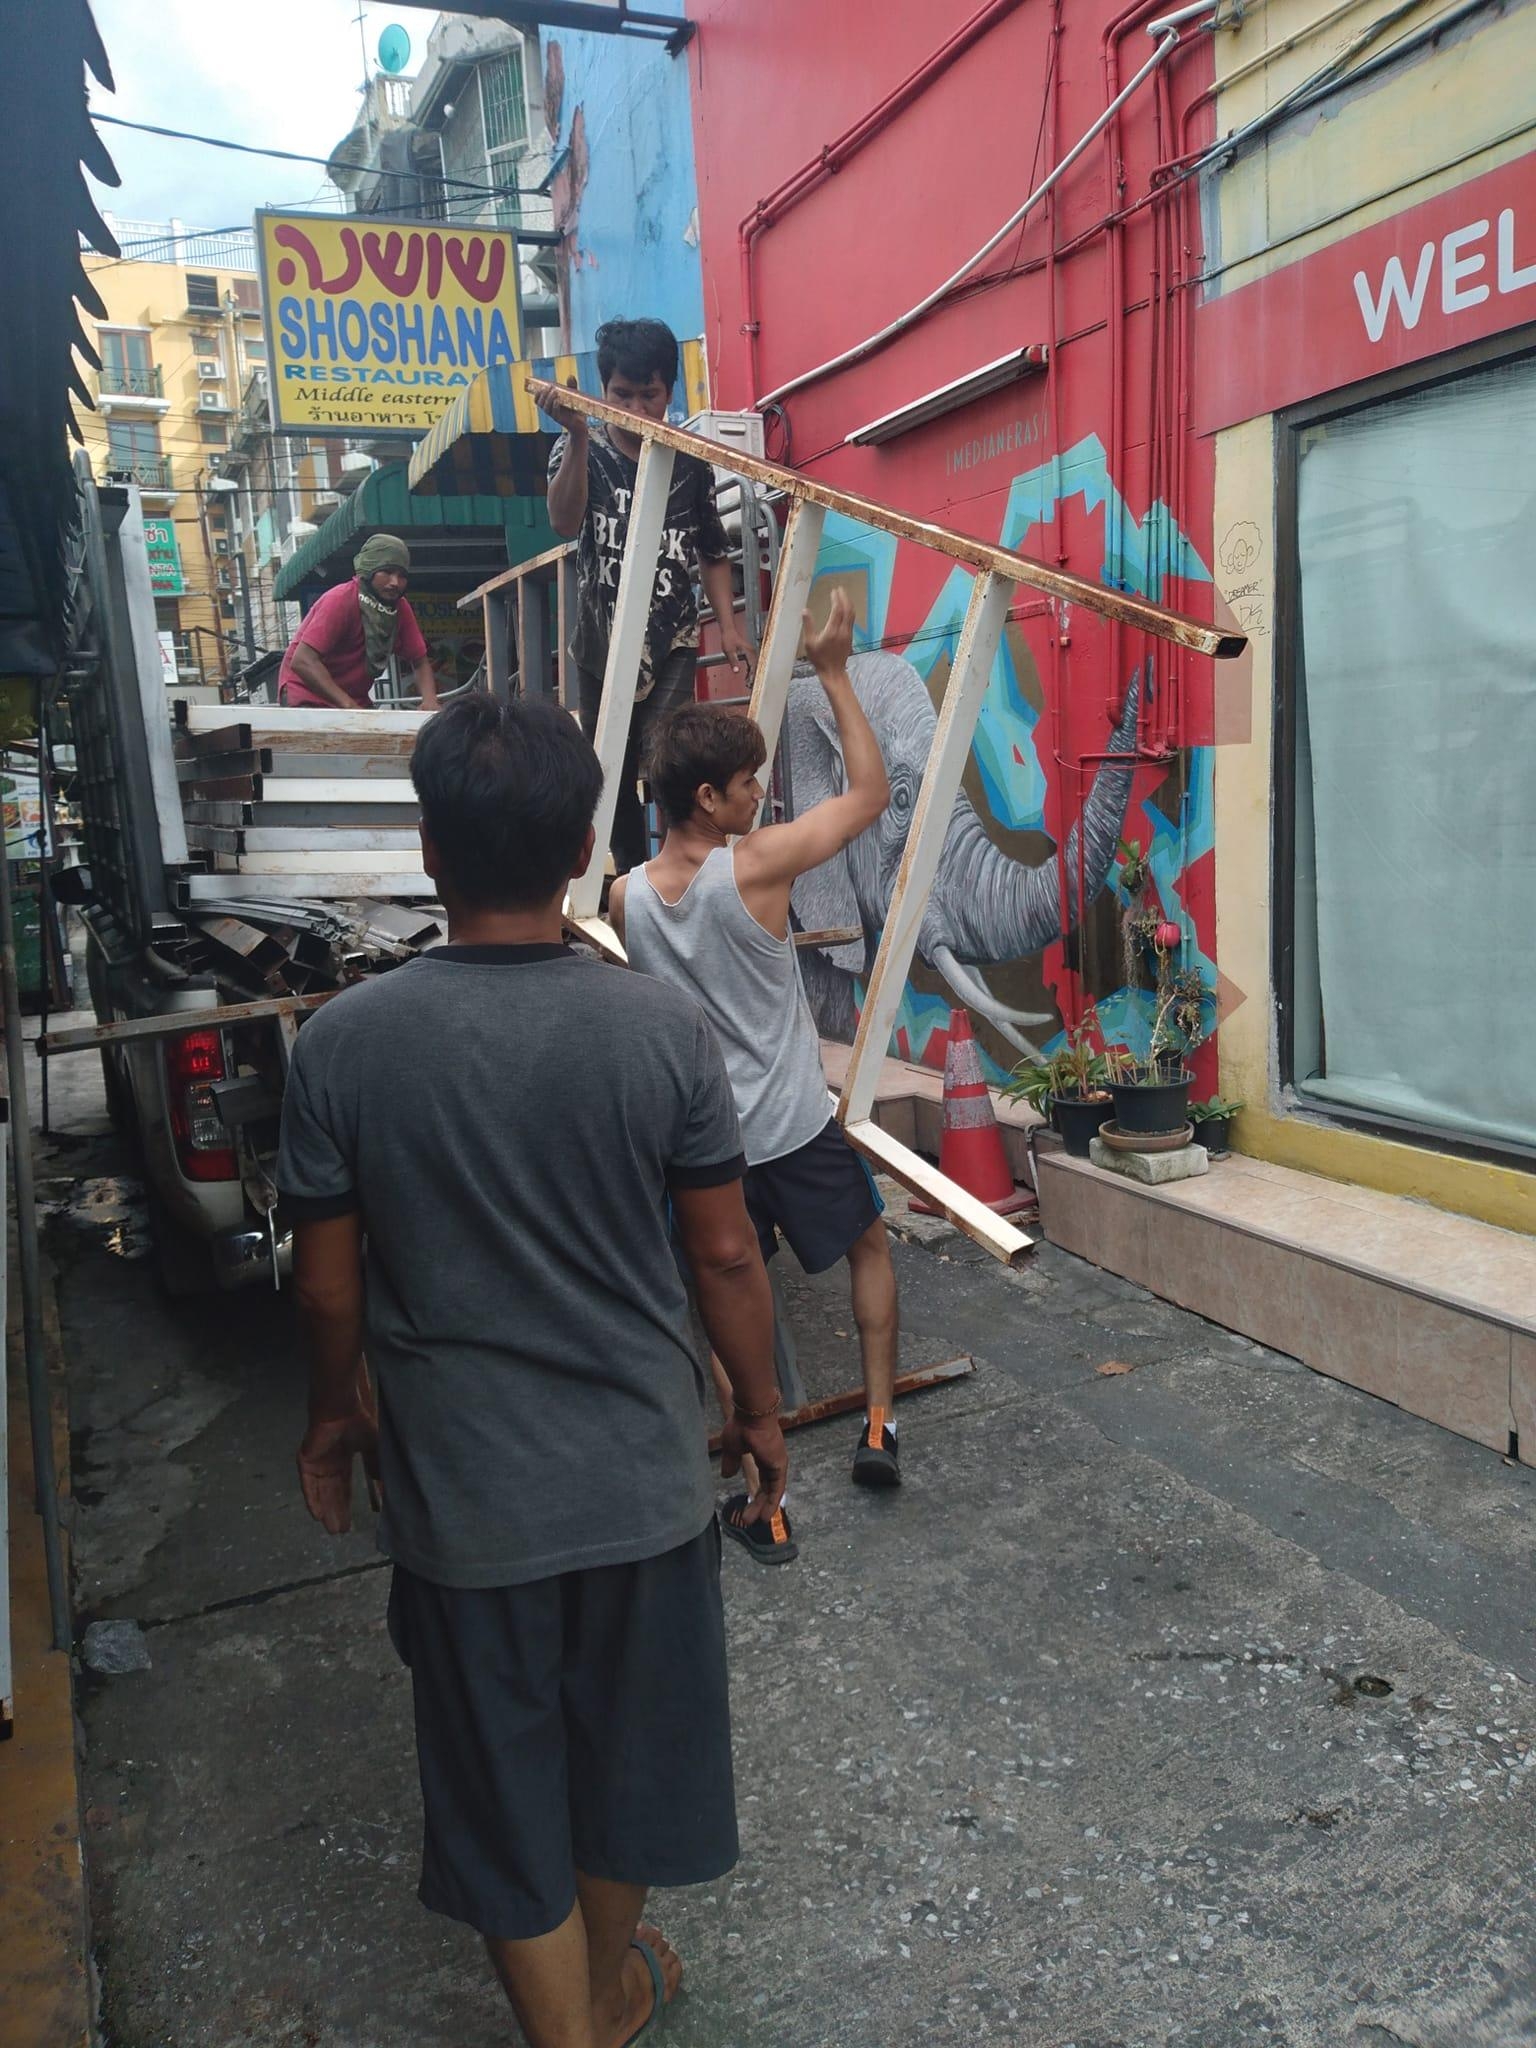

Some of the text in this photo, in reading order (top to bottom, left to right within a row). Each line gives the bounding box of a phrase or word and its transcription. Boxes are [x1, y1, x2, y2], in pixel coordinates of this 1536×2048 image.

[274, 224, 506, 304] שושנה
[278, 296, 515, 367] SHOSHANA
[283, 364, 480, 386] RESTAURA
[294, 386, 374, 403] Middle
[308, 406, 416, 425] ร้านอาหาร
[592, 512, 685, 560] BLK
